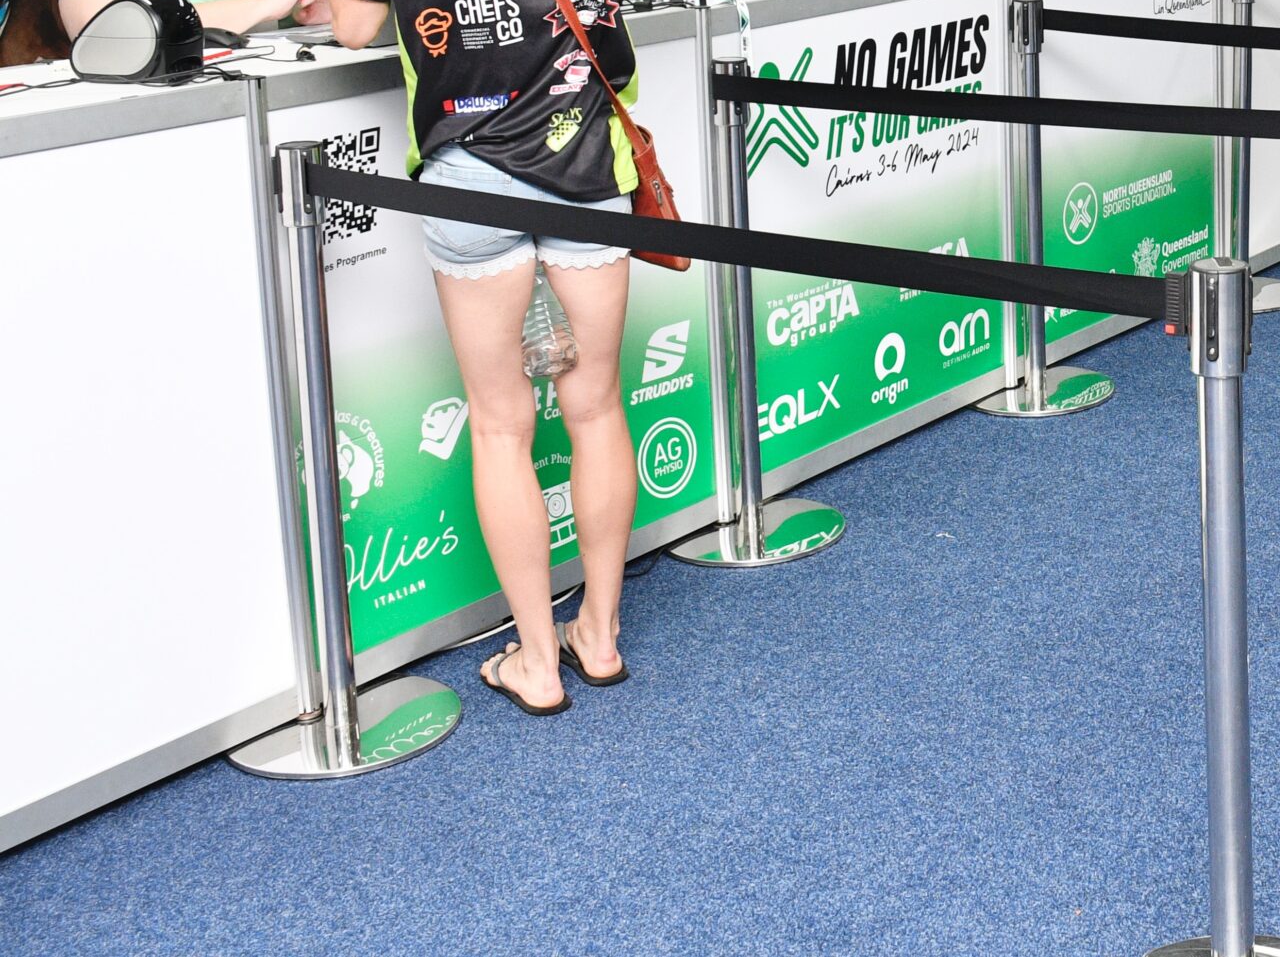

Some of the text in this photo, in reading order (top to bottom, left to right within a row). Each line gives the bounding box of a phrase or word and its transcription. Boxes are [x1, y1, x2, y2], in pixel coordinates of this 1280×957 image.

[495, 17, 524, 44] CO
[886, 14, 990, 90] GAMES
[457, 95, 509, 112] DAWSON
[826, 111, 867, 161] IT'S
[826, 127, 979, 197] Cairns 3-6 May 2024
[1103, 169, 1173, 205] NORTH QUEENSLAND
[1103, 197, 1131, 218] SPORTS
[1162, 224, 1209, 257] Queensland
[336, 247, 387, 268] Programme
[1162, 245, 1209, 274] Government
[767, 299, 784, 309] The
[786, 282, 830, 302] Woodward
[790, 319, 837, 347] group
[943, 343, 990, 369] DEFINING AUDIO
[630, 373, 694, 406] STRUDDYS
[871, 378, 909, 405] origin
[359, 419, 385, 488] Creatures
[551, 453, 572, 466] Phot
[654, 437, 682, 468] AG
[654, 459, 683, 479] PHYSIO
[373, 579, 427, 609] ITALIAN
